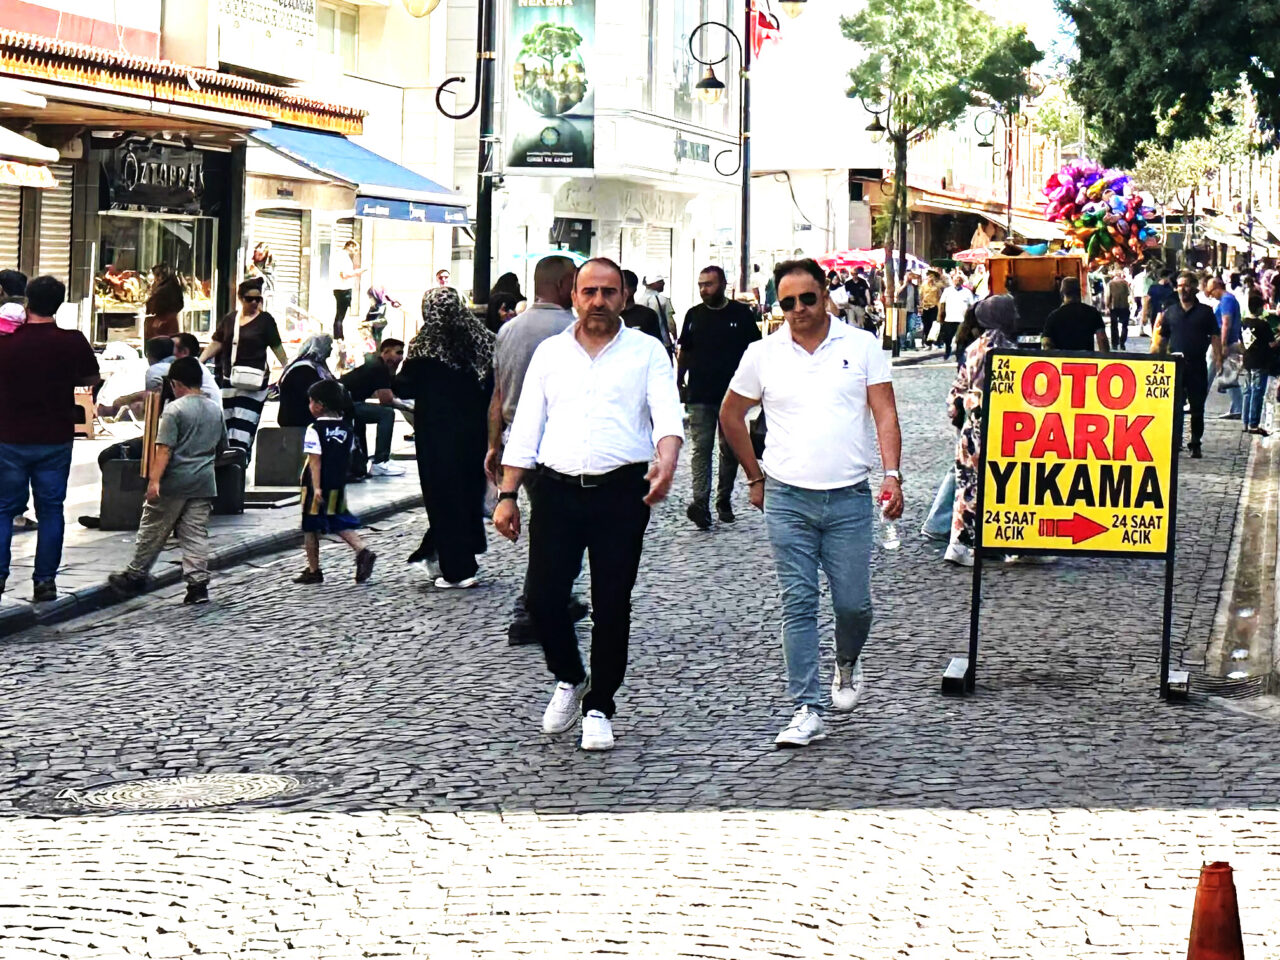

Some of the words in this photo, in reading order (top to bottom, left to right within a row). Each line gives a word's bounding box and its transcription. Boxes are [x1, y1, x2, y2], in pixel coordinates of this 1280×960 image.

[997, 358, 1010, 370] 24
[1152, 363, 1165, 374] 24
[991, 370, 1016, 382] SAAT
[1145, 375, 1171, 386] SAAT
[990, 381, 1014, 395] AÇIK
[1021, 361, 1137, 410] OTO
[1001, 411, 1155, 462] PARK
[988, 461, 1164, 509] YIKAMA
[985, 511, 1000, 524] 24
[1004, 511, 1036, 526] SAAT
[1112, 514, 1128, 529] 24
[1131, 515, 1163, 530] SAAT
[995, 526, 1024, 543] AÇIK
[1122, 529, 1151, 546] AÇIK
